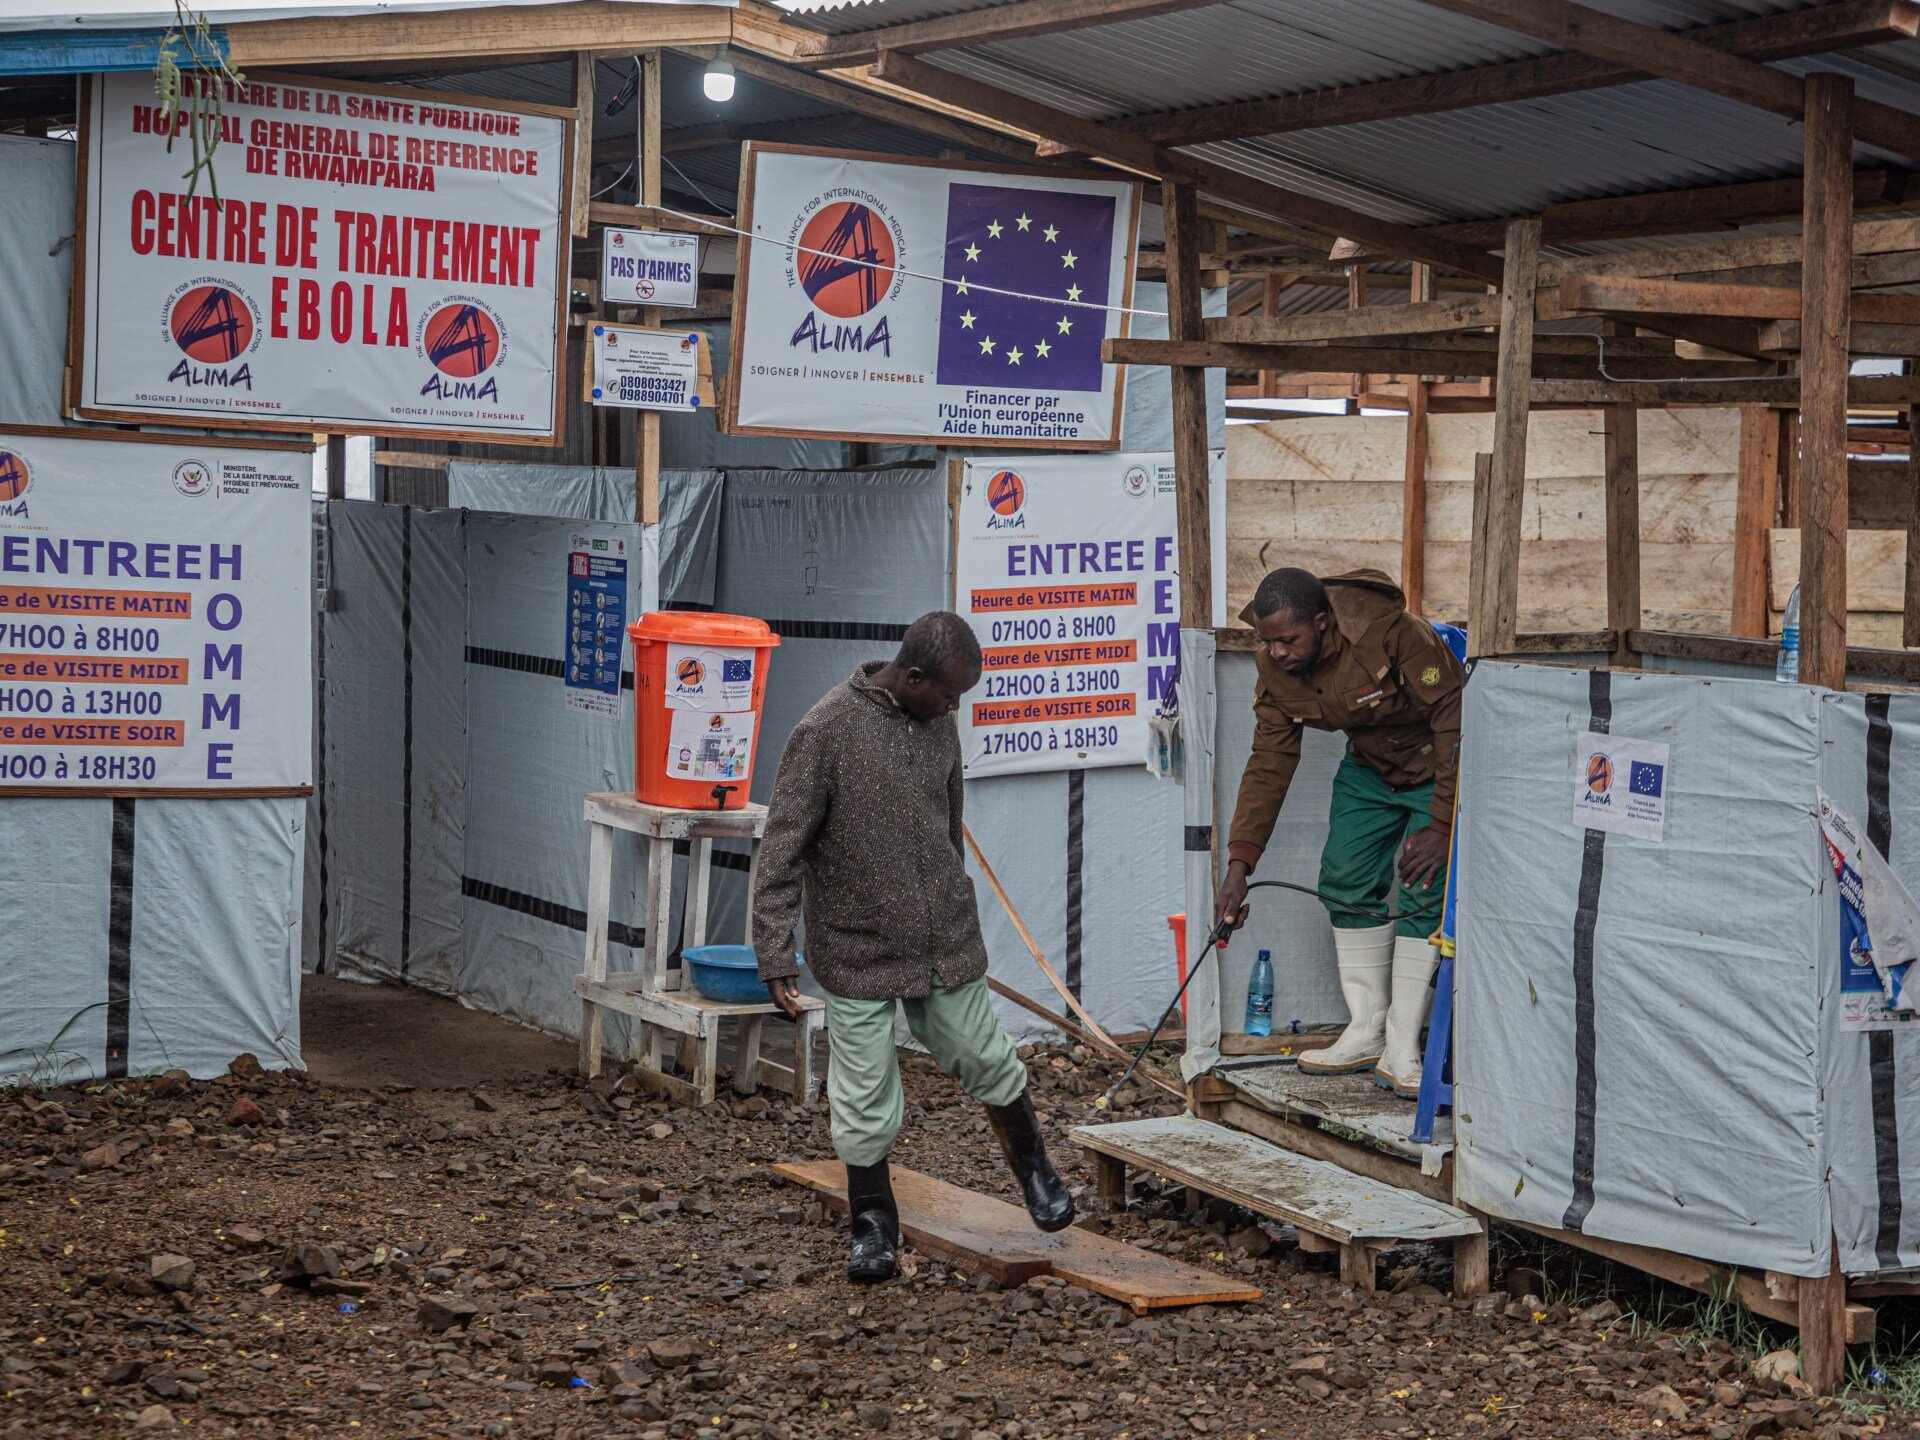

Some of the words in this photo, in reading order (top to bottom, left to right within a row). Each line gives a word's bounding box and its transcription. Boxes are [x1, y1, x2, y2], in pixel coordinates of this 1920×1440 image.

[282, 88, 310, 112] DE
[315, 92, 341, 115] LA
[346, 96, 414, 124] SANTE
[419, 106, 520, 136] PUBLIQUE
[132, 105, 244, 144] HOPITAL
[250, 119, 362, 157] GENERAL
[369, 132, 399, 160] DE
[405, 137, 538, 176] REFERENCE
[246, 146, 278, 175] DE
[284, 151, 435, 192] RWAMPARA
[130, 189, 267, 264] CENTRE
[276, 204, 318, 270] DE
[334, 210, 541, 288] TRAITEMENT
[784, 267, 797, 288] THE
[804, 196, 822, 215] FOR
[823, 187, 888, 216] INTERNATIONAL
[888, 215, 907, 259] MEDICAL
[610, 256, 634, 278] PAS
[638, 258, 692, 283] D'ARMES
[174, 283, 190, 295] FOR
[190, 276, 246, 296] INTERNATIONAL
[246, 295, 262, 324] MEDICAL
[270, 276, 409, 348] EBOLA
[428, 300, 442, 312] FOR
[442, 295, 492, 313] INTERNATIONAL
[161, 329, 170, 344] THE
[492, 312, 508, 340] MEDICAL
[790, 310, 892, 358] ALIMA
[250, 328, 262, 354] ACTION
[496, 343, 508, 368] ACTION
[167, 358, 253, 392] ALIMA
[620, 376, 686, 392] 0808033421
[750, 366, 800, 376] SOIGNER
[811, 368, 859, 380] INNOVER
[870, 372, 925, 384] ENSEMBLE
[420, 372, 499, 404] ALIMA
[620, 388, 684, 404] 0988904701
[135, 394, 176, 402] SOIGNER
[186, 397, 226, 406] INNOVER
[235, 400, 282, 409] ENSEMBLE
[966, 390, 1030, 406] Financer
[1035, 396, 1060, 410] par
[390, 406, 428, 415] SOIGNER
[436, 410, 474, 418] INNOVER
[482, 412, 525, 420] ENSEMBLE
[938, 404, 991, 420] l'Union
[996, 408, 1084, 424] européenne
[943, 420, 977, 434] Aide
[986, 513, 1026, 530] ALIMA
[2, 535, 202, 580] ENTREE
[1008, 540, 1144, 577] ENTREE
[15, 593, 40, 608] de
[47, 594, 116, 610] VISITE
[123, 597, 188, 613] MATIN
[971, 595, 1013, 608] Heure
[1017, 593, 1034, 606] de
[1038, 590, 1086, 605] VISITE
[1090, 588, 1135, 602] MATIN
[74, 624, 87, 650] à
[1057, 616, 1066, 639] à
[1024, 651, 1040, 664] de
[1044, 648, 1092, 662] VISITE
[1096, 646, 1130, 659] MIDI
[22, 660, 48, 676] de
[54, 662, 124, 678] VISITE
[130, 664, 179, 679] MIDI
[676, 684, 704, 694] ALIMA
[1050, 671, 1060, 694] à
[62, 687, 75, 714] à
[978, 708, 1020, 721] Heure
[1024, 705, 1040, 718] de
[1044, 702, 1092, 716] VISITE
[1096, 699, 1132, 713] SOIR
[22, 724, 45, 739] de
[52, 724, 121, 740] VISITE
[127, 726, 177, 741] SOIR
[1049, 728, 1058, 750] à
[1064, 726, 1118, 748] 18H30
[54, 753, 68, 779] à
[78, 756, 156, 780] 18H30
